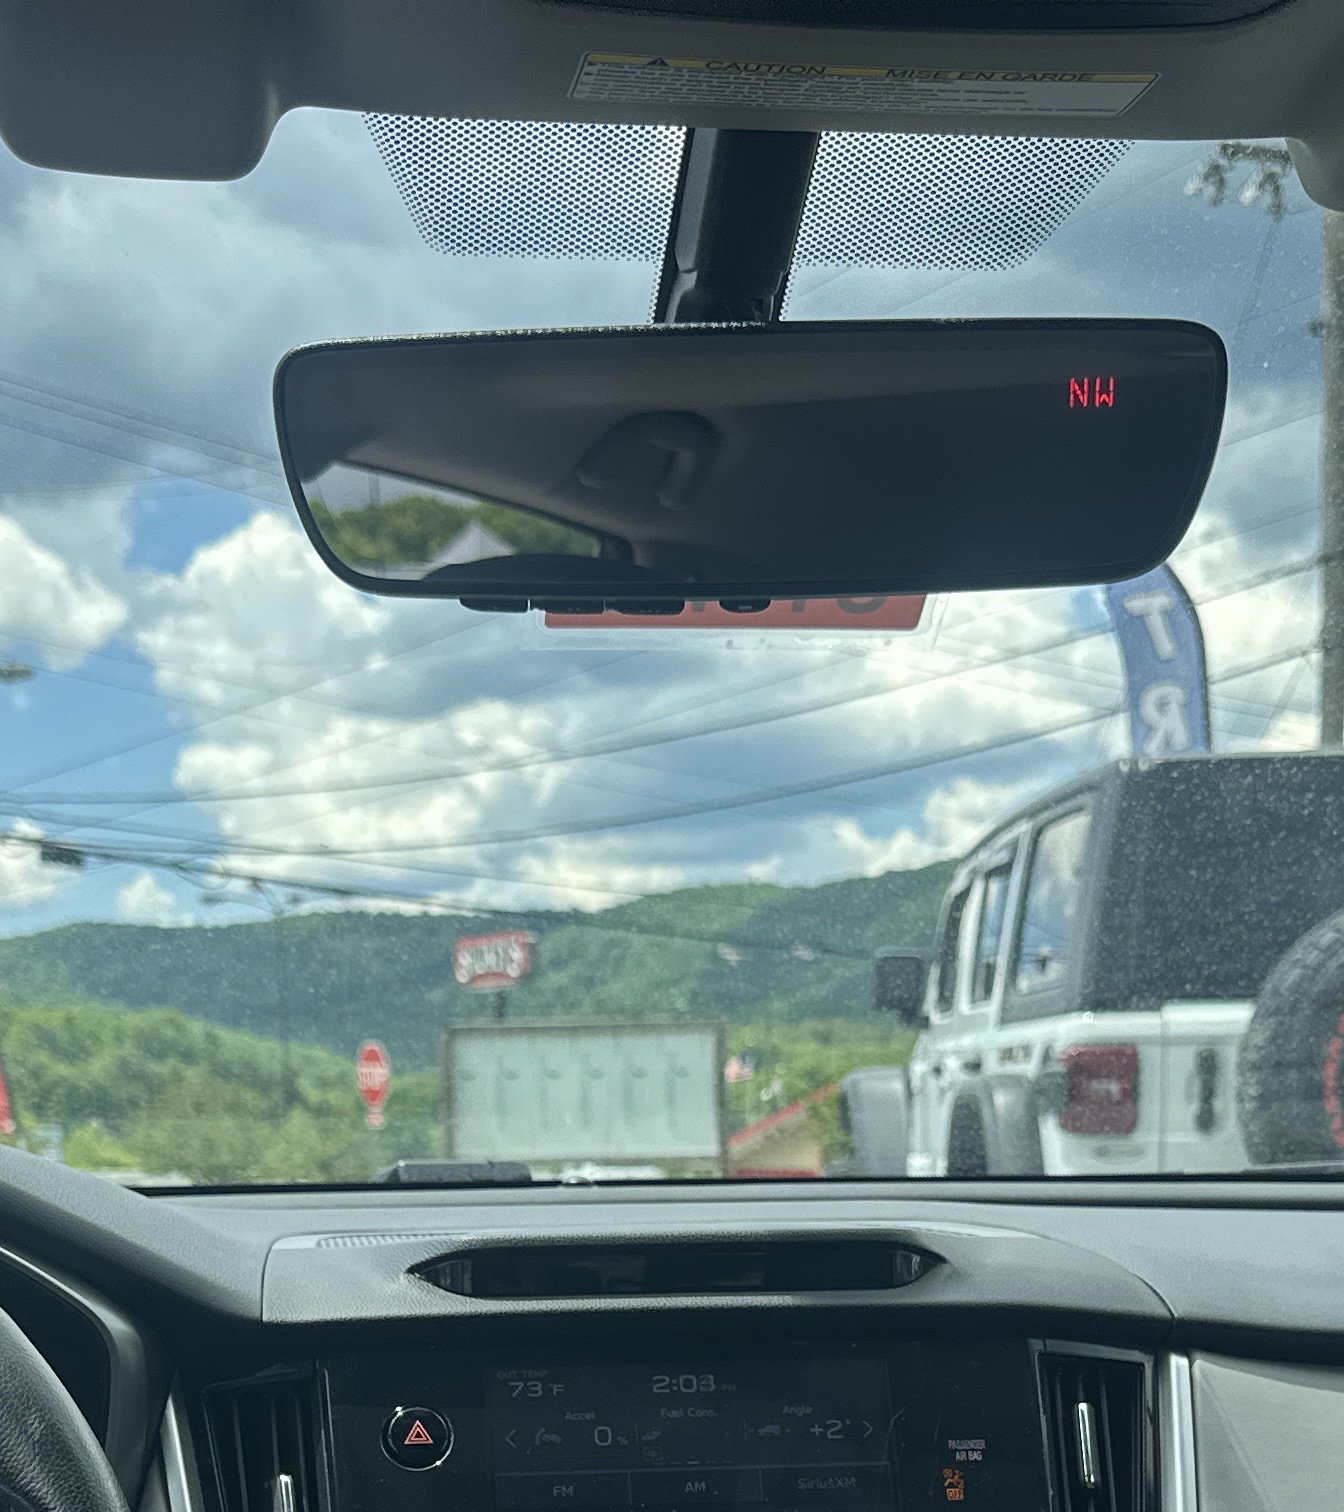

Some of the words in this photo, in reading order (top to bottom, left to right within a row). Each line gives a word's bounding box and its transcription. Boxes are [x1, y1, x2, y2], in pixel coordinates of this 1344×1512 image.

[705, 61, 827, 76] CAUTION
[885, 69, 946, 80] MISE
[958, 71, 994, 81] EN
[1002, 72, 1096, 82] GARDE
[1069, 376, 1114, 408] NW
[508, 1381, 543, 1397] 73
[685, 1481, 706, 1493] AM
[797, 1477, 856, 1489] SiriusXM
[553, 1486, 574, 1497] FM
